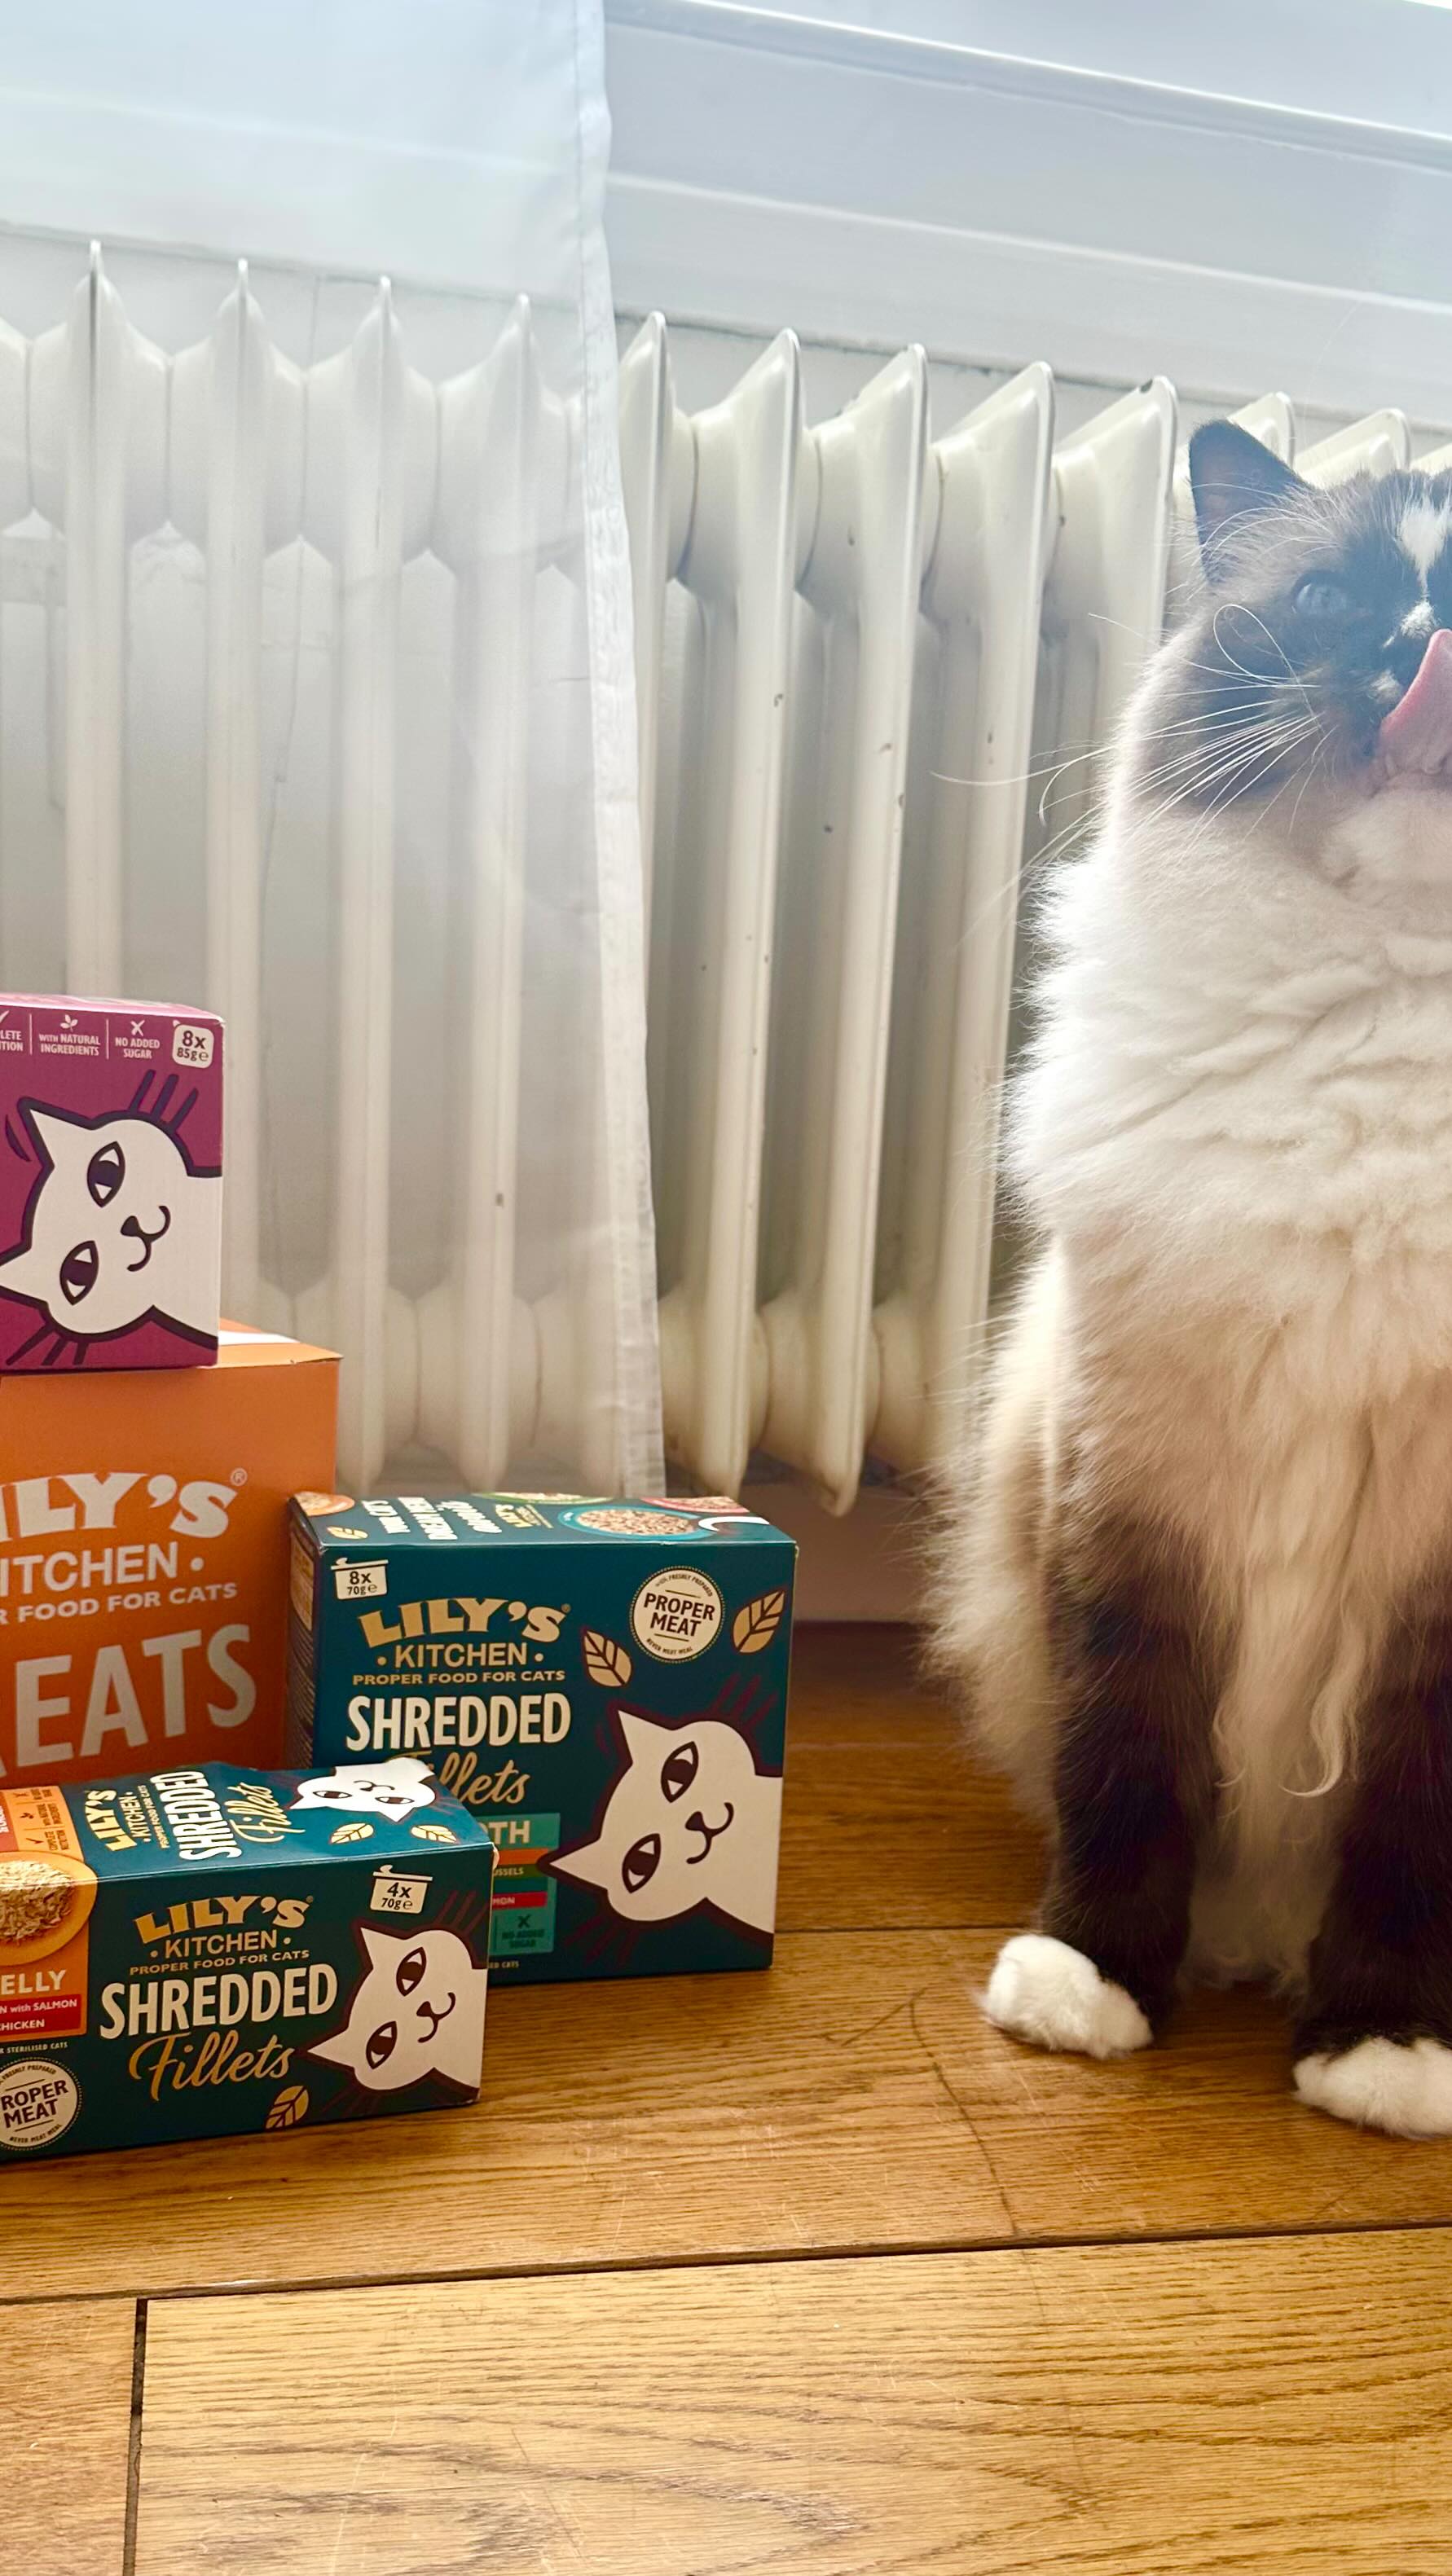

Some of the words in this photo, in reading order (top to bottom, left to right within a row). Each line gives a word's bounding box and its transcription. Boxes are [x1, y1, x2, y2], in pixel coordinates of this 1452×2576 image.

[0, 1030, 22, 1040] LETE
[60, 1034, 101, 1045] NATURAL
[115, 1037, 128, 1048] NO
[130, 1039, 160, 1048] ADDED
[182, 1031, 206, 1049] 8x
[41, 1044, 99, 1056] INGREDIENTS
[123, 1049, 152, 1059] SUGAR
[0, 1471, 238, 1542] LY'S
[0, 1541, 178, 1597] ITCHEN
[350, 1571, 372, 1585] 8x
[18, 1597, 99, 1623] FOOD
[108, 1590, 161, 1612] FOR
[169, 1583, 238, 1604] CATS
[643, 1592, 715, 1621] PROPER
[359, 1597, 567, 1648] LILY'S
[650, 1611, 702, 1637] MEAT
[395, 1642, 527, 1668] KITCHEN
[352, 1673, 423, 1685] PROPER
[428, 1672, 477, 1684] FOOD
[482, 1671, 517, 1682] FOR
[521, 1670, 565, 1681] CATS
[0, 1624, 257, 1778] EATS
[346, 1692, 571, 1752] SHREDDED
[85, 1790, 137, 1852] LILY'S
[118, 1796, 152, 1838] KITCHEN
[150, 1770, 242, 1861] SHREDDED
[224, 1782, 306, 1843] Fillets
[493, 1867, 524, 1877] USSELS
[387, 1883, 412, 1898] 4x
[134, 1895, 310, 1944] LILY'S
[165, 1929, 278, 1958] KITCHEN
[130, 1961, 189, 1976] PROPER
[194, 1957, 235, 1969] FOOD
[240, 1954, 268, 1964] FOR
[272, 1950, 310, 1962] CATS
[1, 1969, 67, 1995] ELLY
[10, 2003, 31, 2013] with
[33, 1998, 77, 2011] SALMON
[99, 1963, 338, 2039] SHREDDED
[7, 2043, 48, 2053] STERILISED
[51, 2042, 68, 2051] CATS
[129, 2029, 295, 2103] Fillets
[1, 2079, 68, 2110] ROPER
[4, 2099, 59, 2128] MEAT
